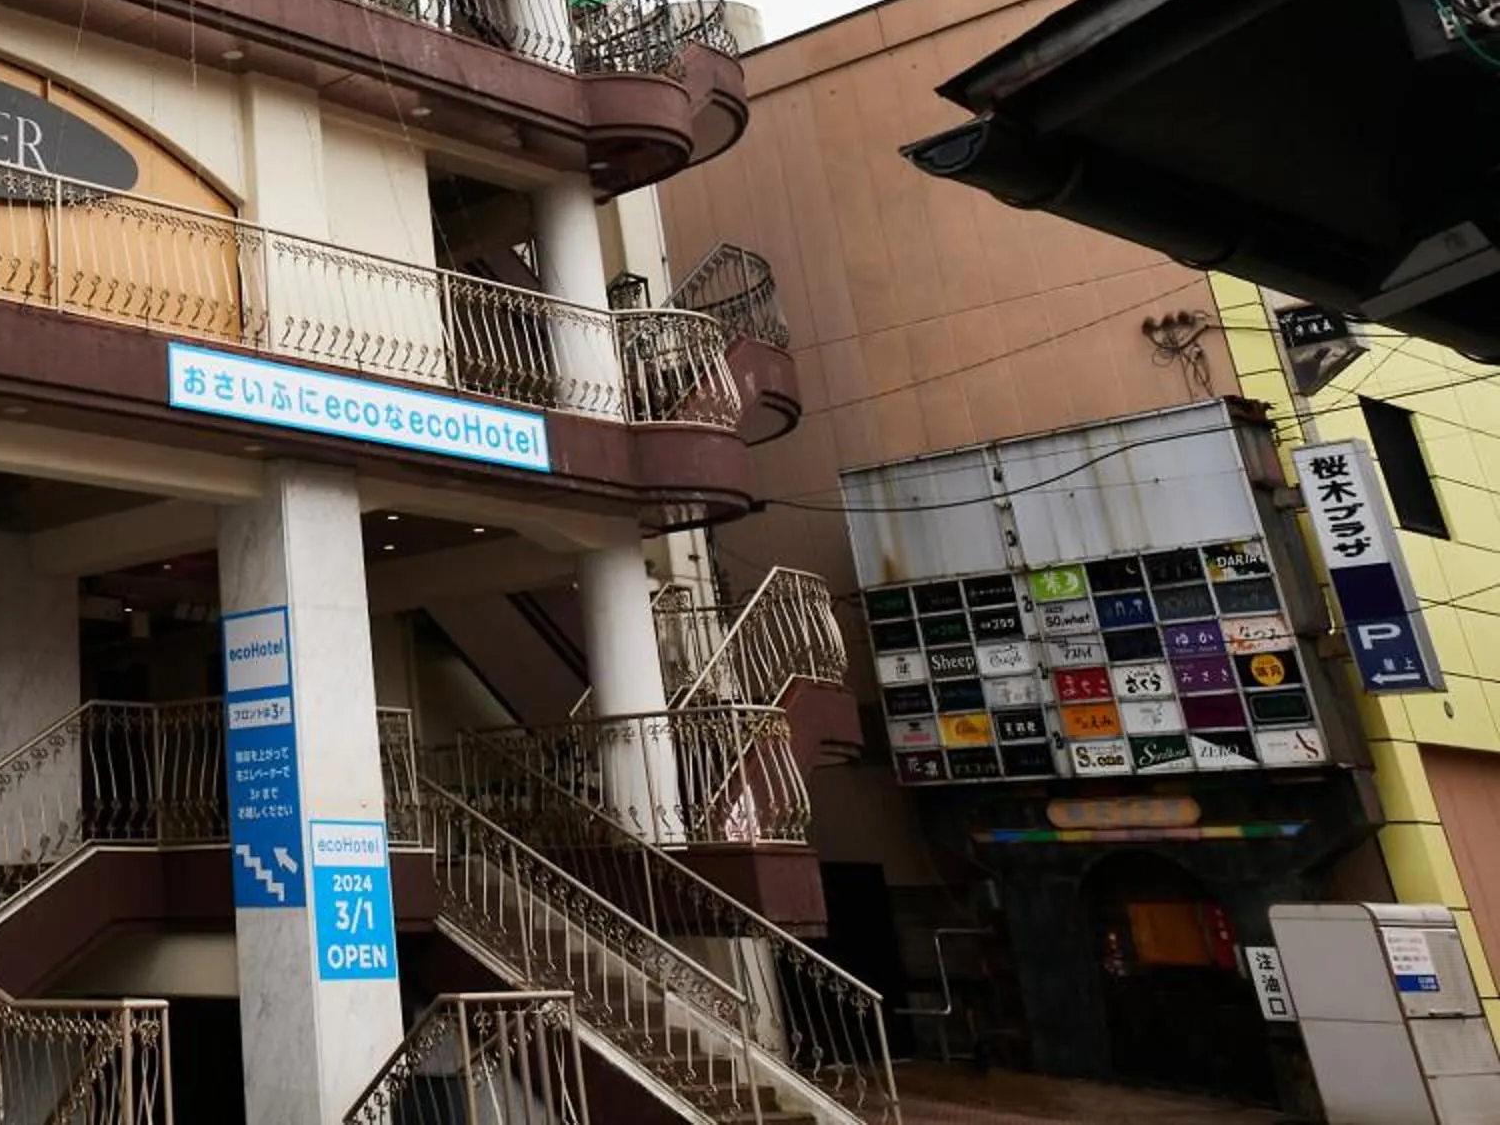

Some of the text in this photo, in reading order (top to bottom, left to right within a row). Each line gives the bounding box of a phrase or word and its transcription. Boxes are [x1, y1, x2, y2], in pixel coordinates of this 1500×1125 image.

[183, 363, 539, 457] おさいふにecoなecoHotel
[1310, 454, 1371, 558] 桜木プラザ
[229, 638, 285, 661] ecoHotel
[1357, 622, 1402, 651] P
[931, 653, 976, 672] Sheep
[1125, 674, 1161, 694] さくら
[317, 836, 381, 854] ecoHotel
[333, 874, 372, 893] 2024
[335, 899, 374, 934] 3/1
[327, 944, 388, 970] OPEN
[1255, 951, 1287, 1016] 注油口
